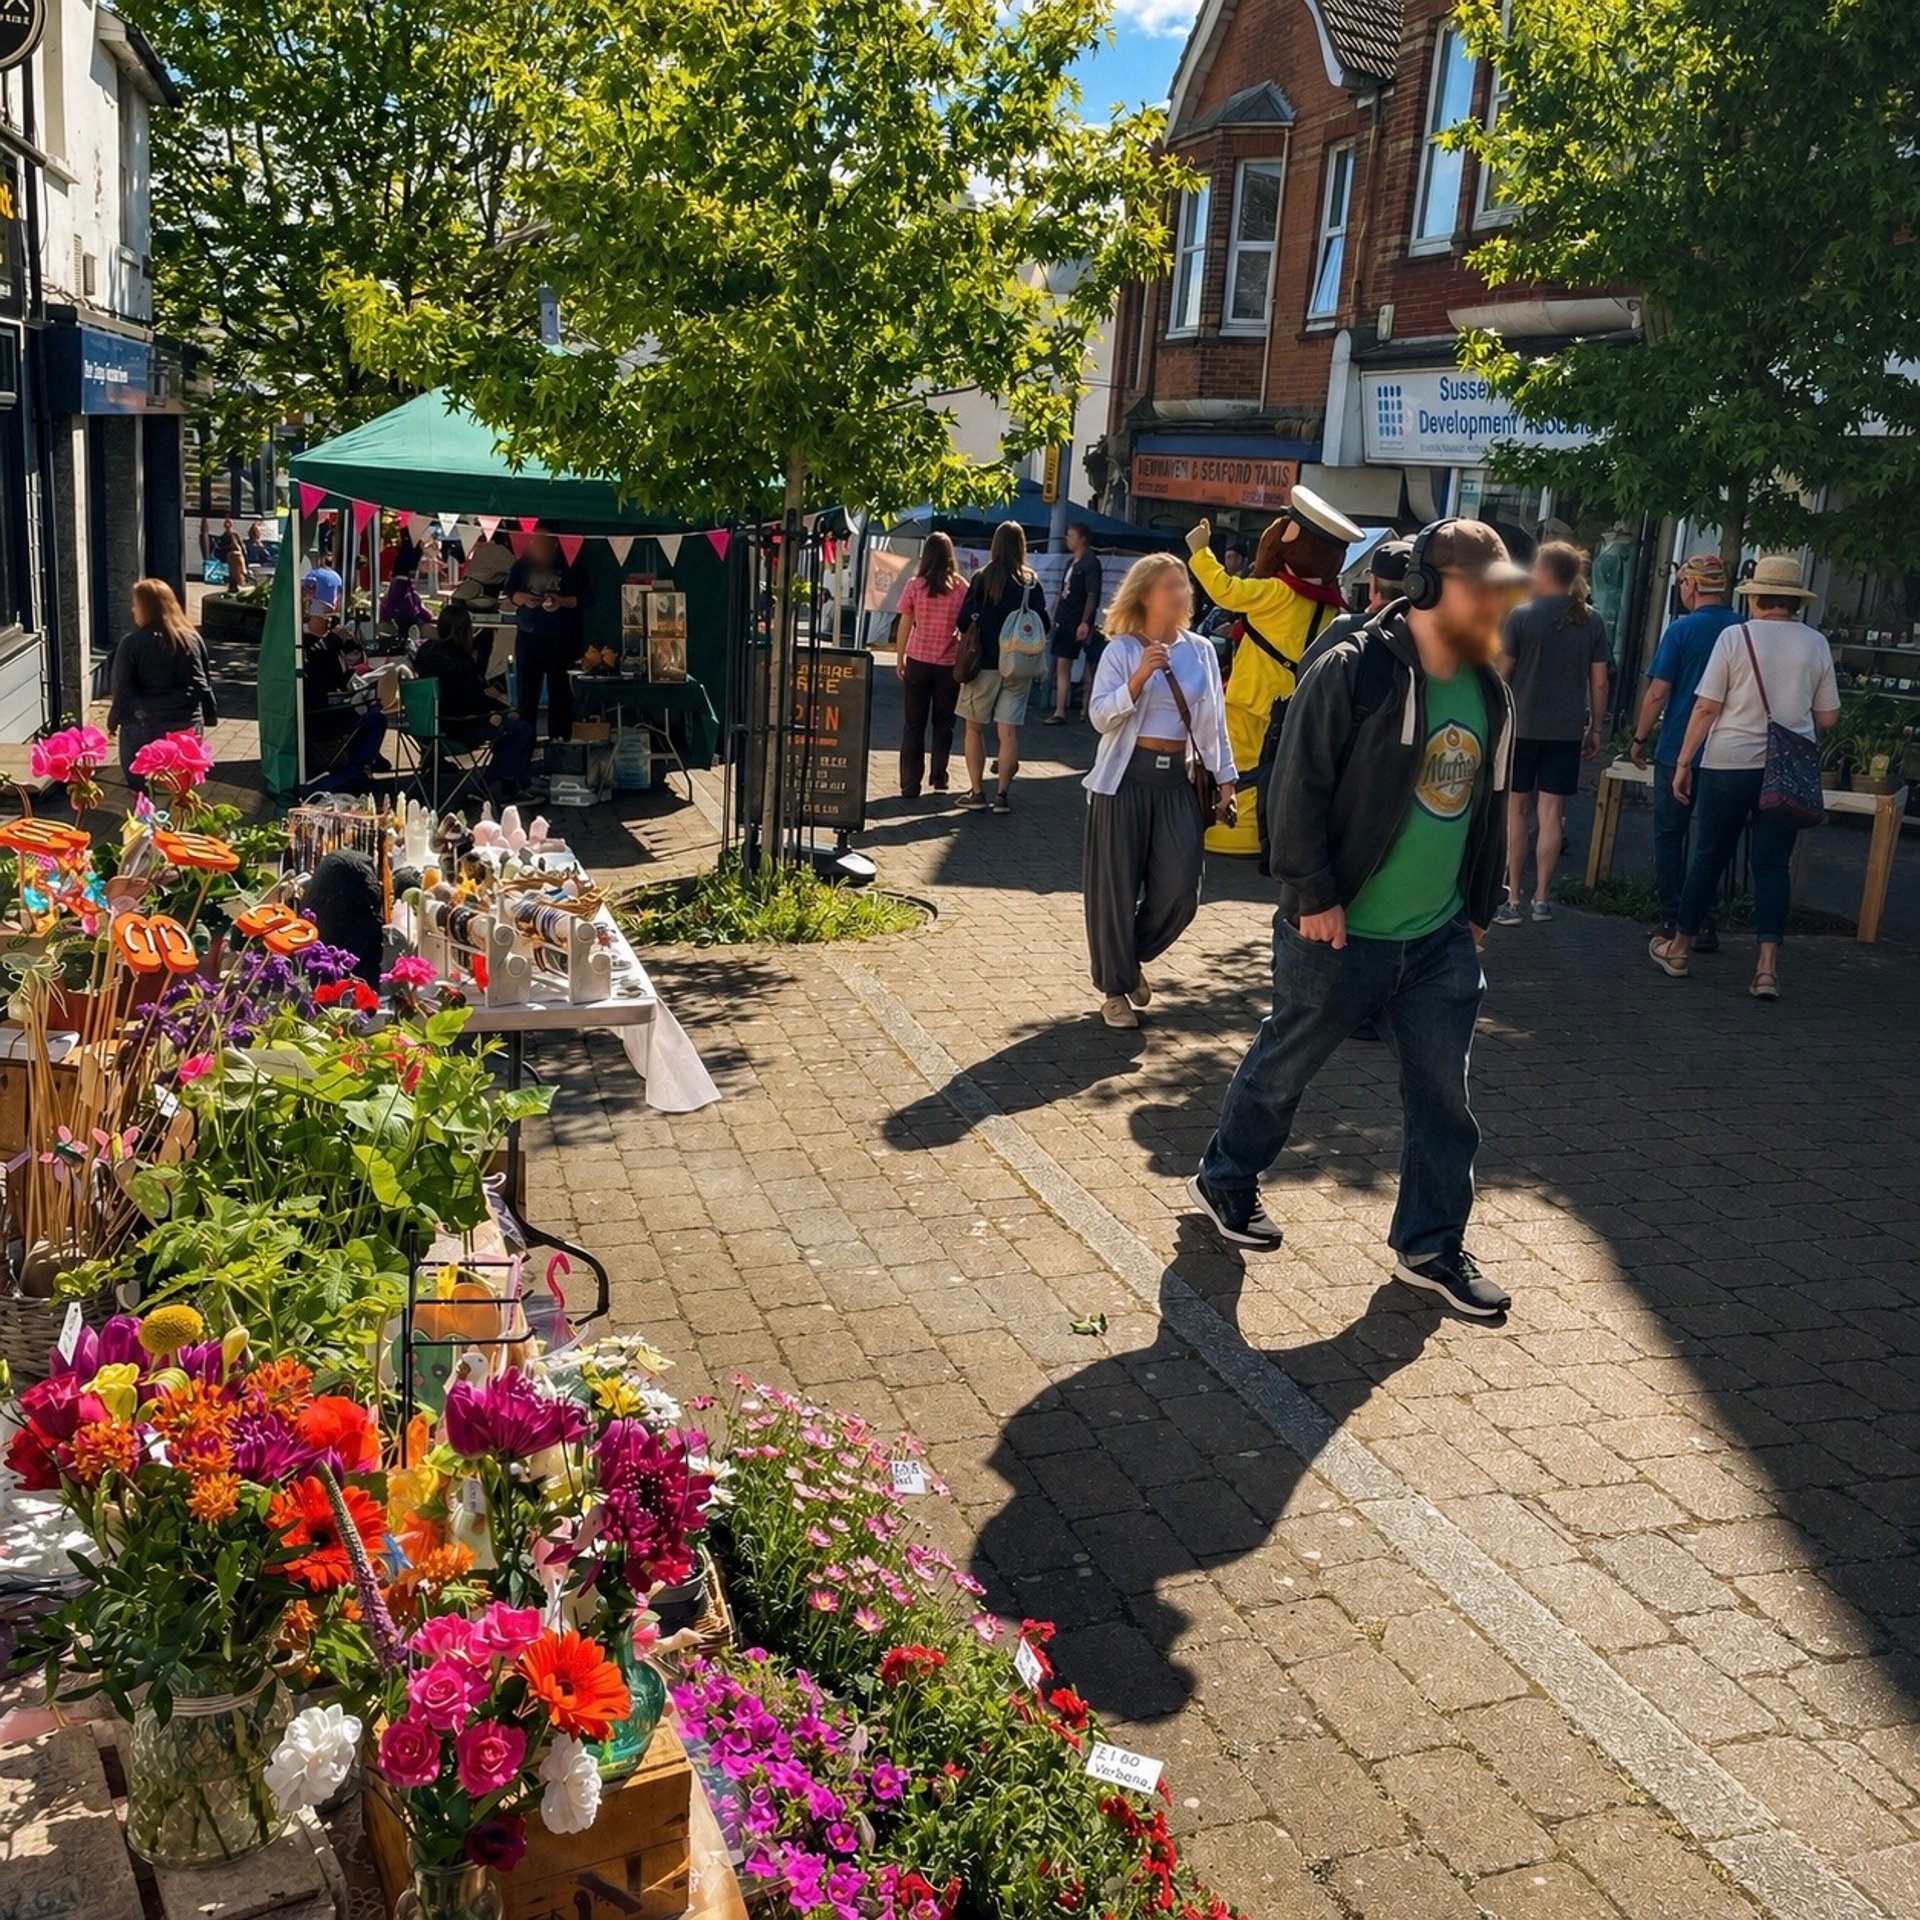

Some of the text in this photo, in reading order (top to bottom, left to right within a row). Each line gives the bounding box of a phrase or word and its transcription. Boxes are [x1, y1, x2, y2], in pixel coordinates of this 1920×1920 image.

[1419, 409, 1518, 440] Development
[1201, 461, 1252, 485] SEAFORD
[1255, 464, 1290, 488] TAXIS
